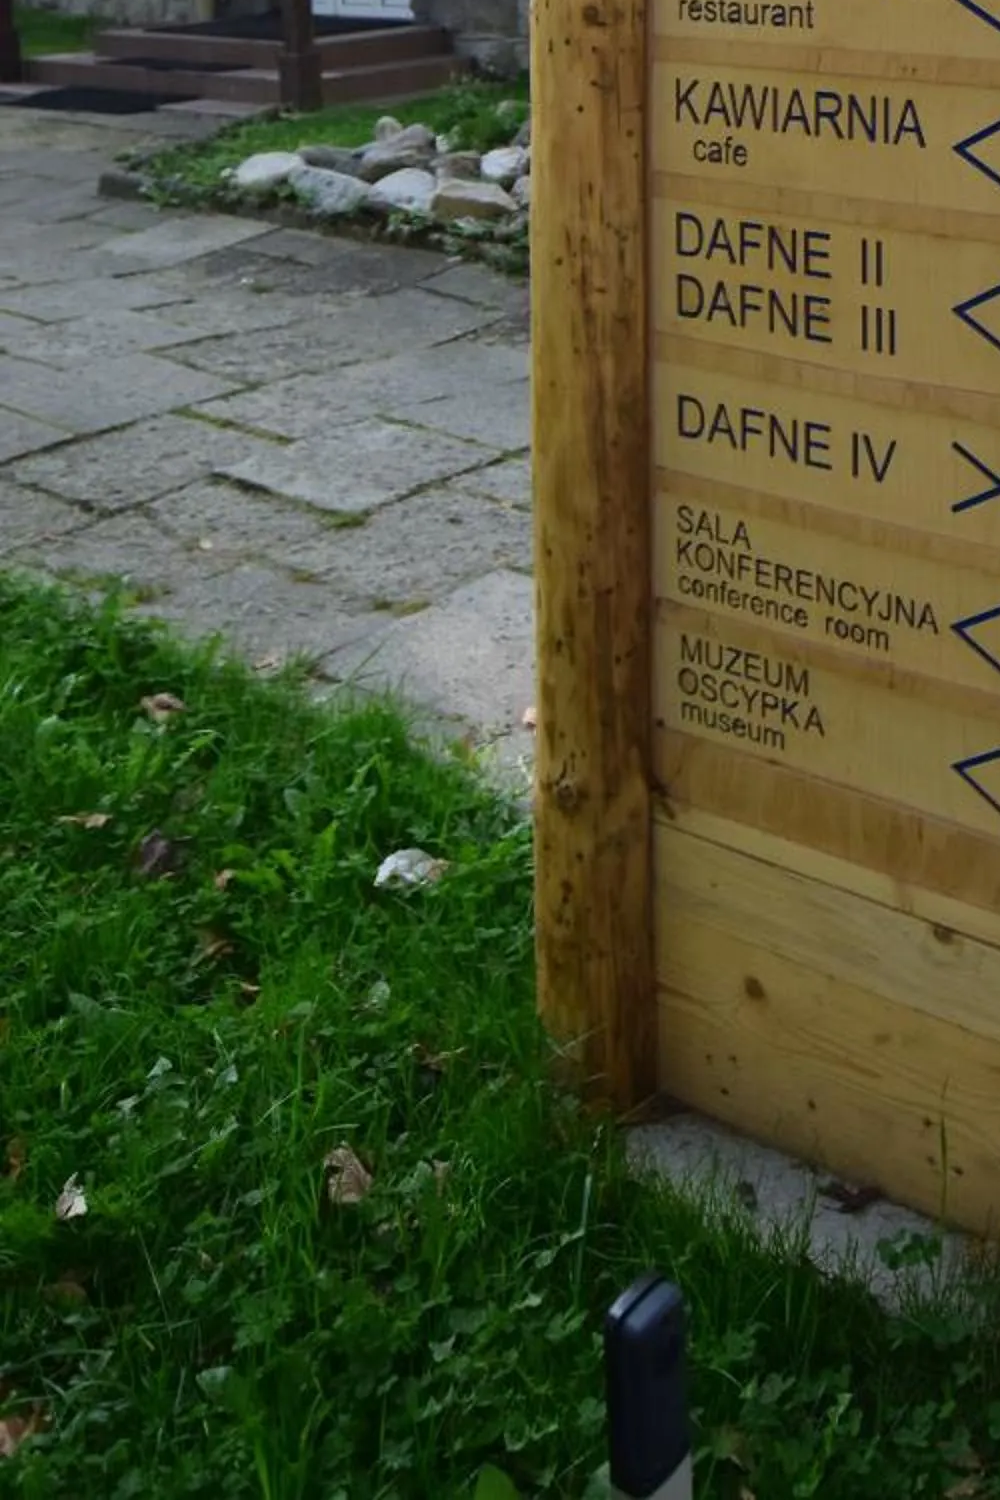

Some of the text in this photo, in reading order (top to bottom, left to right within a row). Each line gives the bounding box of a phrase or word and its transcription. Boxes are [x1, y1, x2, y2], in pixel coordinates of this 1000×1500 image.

[675, 77, 927, 149] KAWIARNIA
[692, 135, 748, 167] cafe
[675, 211, 883, 288] DAFNE II
[676, 273, 896, 357] DAFNE III
[677, 394, 897, 484] DAFNE IV
[677, 505, 752, 551] SALA
[677, 538, 940, 636] KONFERENCYJNA
[679, 575, 891, 652] conference room
[681, 634, 809, 697] MUZEUM
[678, 667, 825, 737] OSCYPKA
[681, 701, 785, 750] museum
